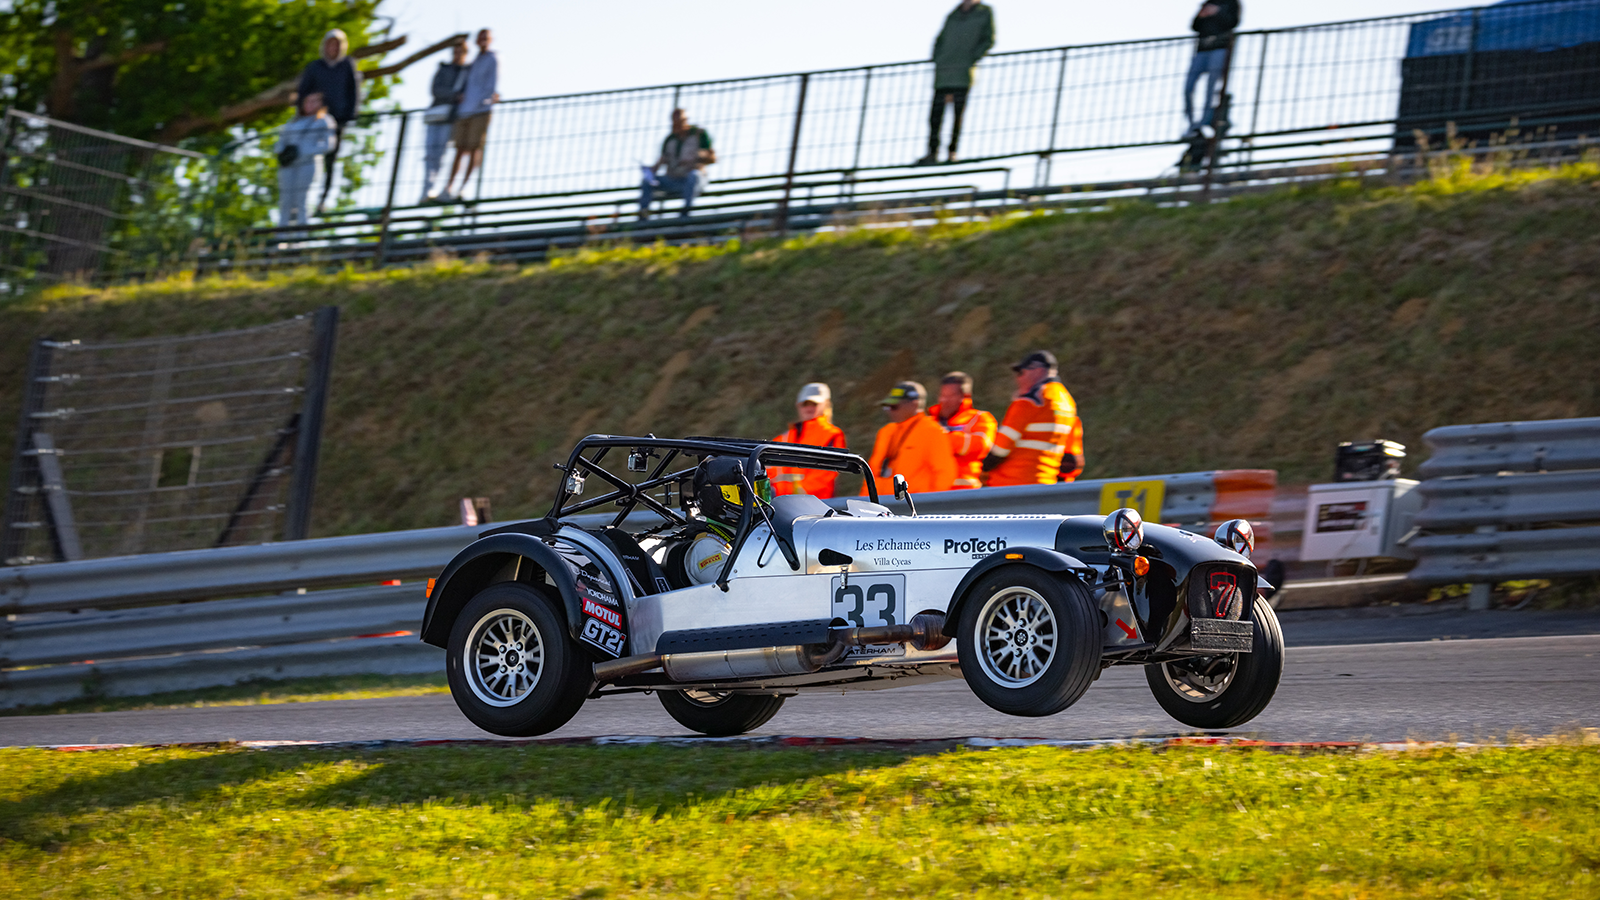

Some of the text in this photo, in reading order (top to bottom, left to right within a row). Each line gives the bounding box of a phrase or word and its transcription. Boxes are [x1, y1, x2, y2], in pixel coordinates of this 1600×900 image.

[855, 537, 931, 551] Les Echamées
[699, 554, 721, 568] PIRELLI
[873, 557, 912, 567] Villa Cycas
[586, 587, 620, 607] YOKOHAMA
[1210, 571, 1237, 618] 7
[584, 600, 621, 627] MOTUL
[834, 583, 897, 628] 33
[584, 617, 625, 653] GT2i
[848, 647, 896, 655] ATERHAM
